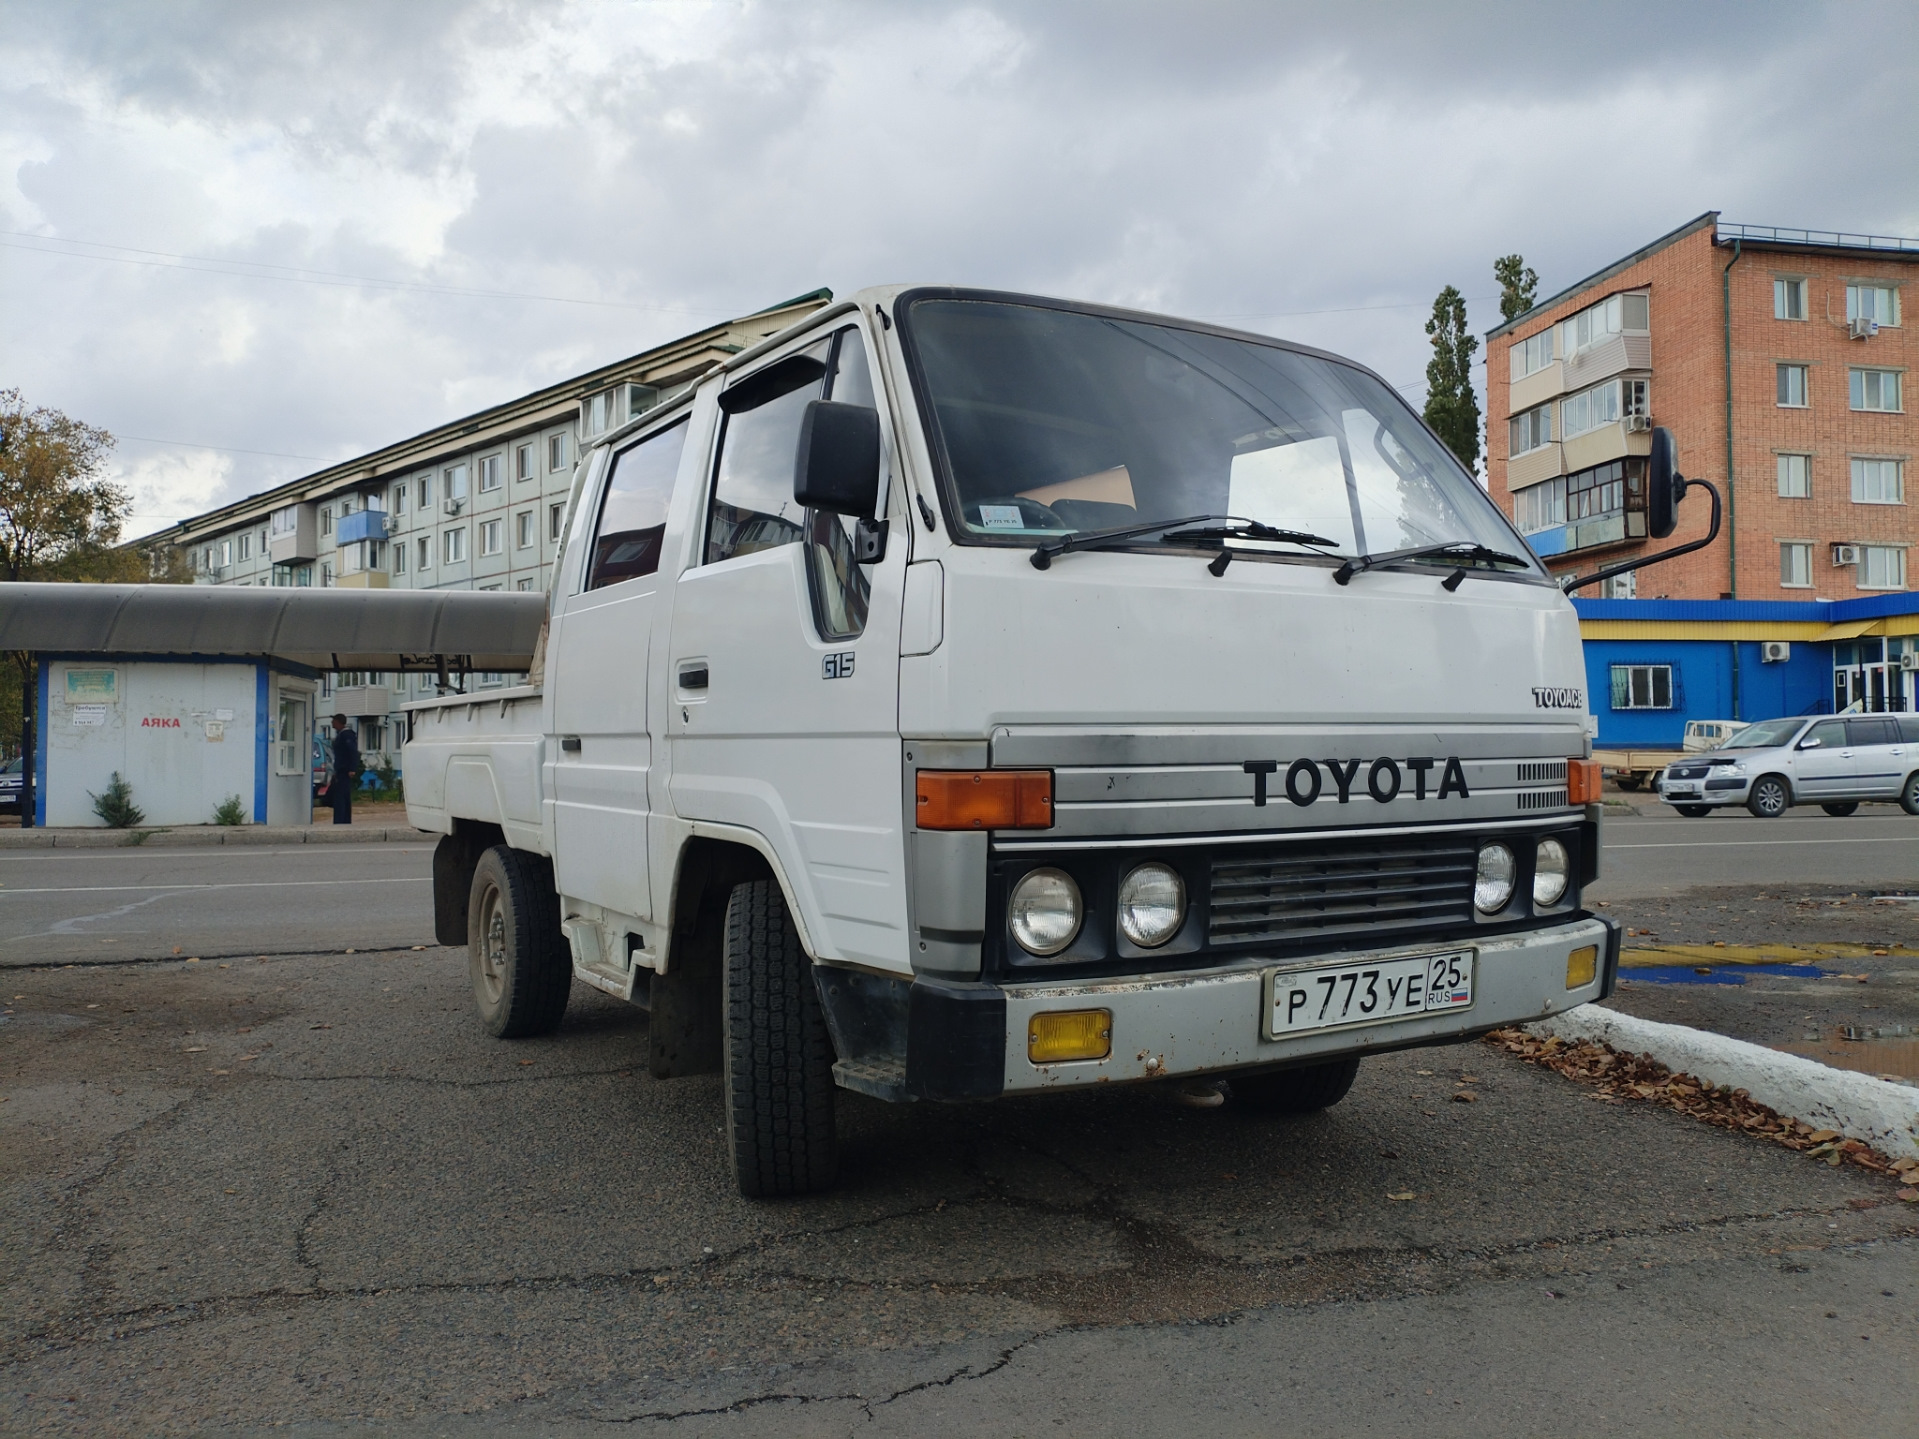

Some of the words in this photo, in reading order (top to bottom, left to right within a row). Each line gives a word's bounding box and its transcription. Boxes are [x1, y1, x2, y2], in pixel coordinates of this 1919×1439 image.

[822, 651, 855, 680] G15
[1532, 687, 1582, 709] TOYOACE
[141, 717, 181, 728] АЯКА
[1243, 756, 1470, 807] TOYOTA
[1431, 956, 1462, 991] 25
[1427, 991, 1451, 1004] RUS
